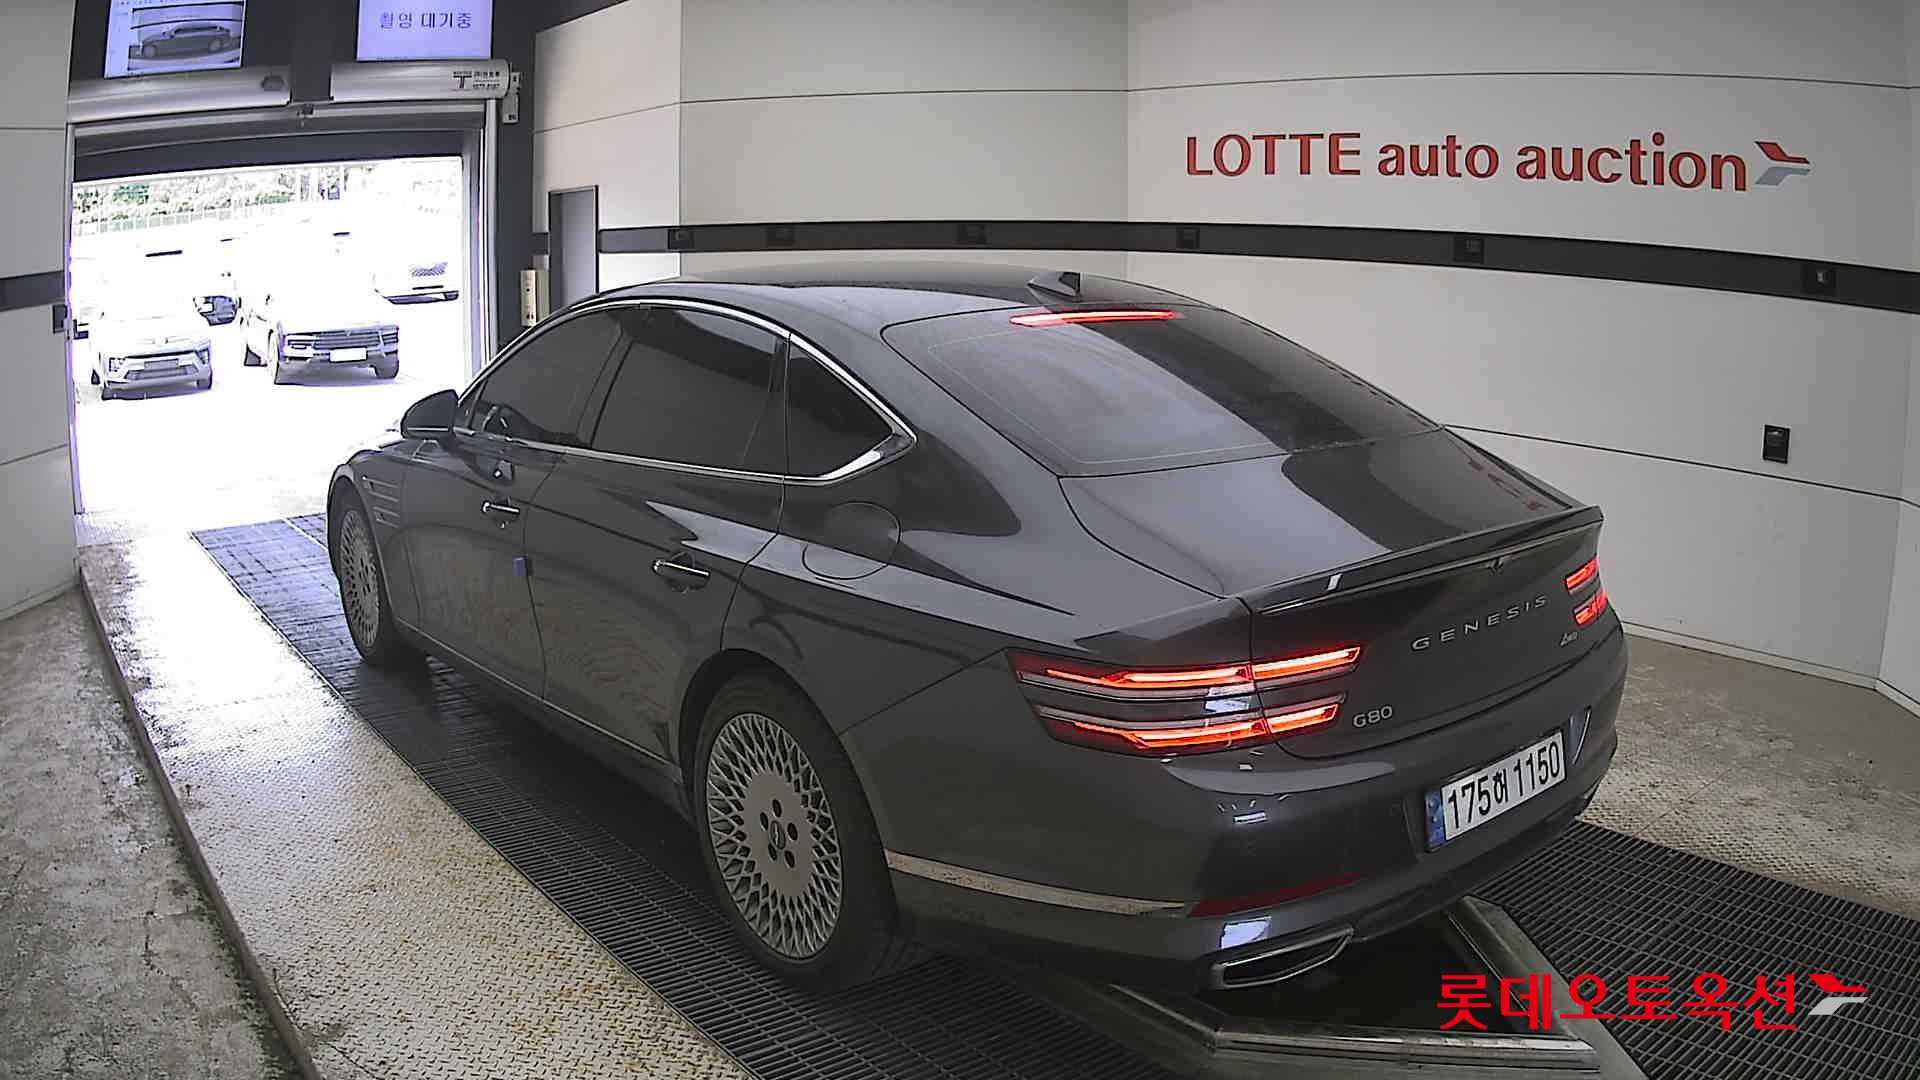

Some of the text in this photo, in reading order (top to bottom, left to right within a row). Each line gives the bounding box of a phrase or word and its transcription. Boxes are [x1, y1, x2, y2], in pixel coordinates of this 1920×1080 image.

[421, 12, 472, 29] 대기중
[1187, 133, 1747, 191] LOTTE auto auction
[1411, 593, 1548, 651] GENESIS
[1352, 705, 1394, 728] G80
[1448, 742, 1559, 828] 175허 1150
